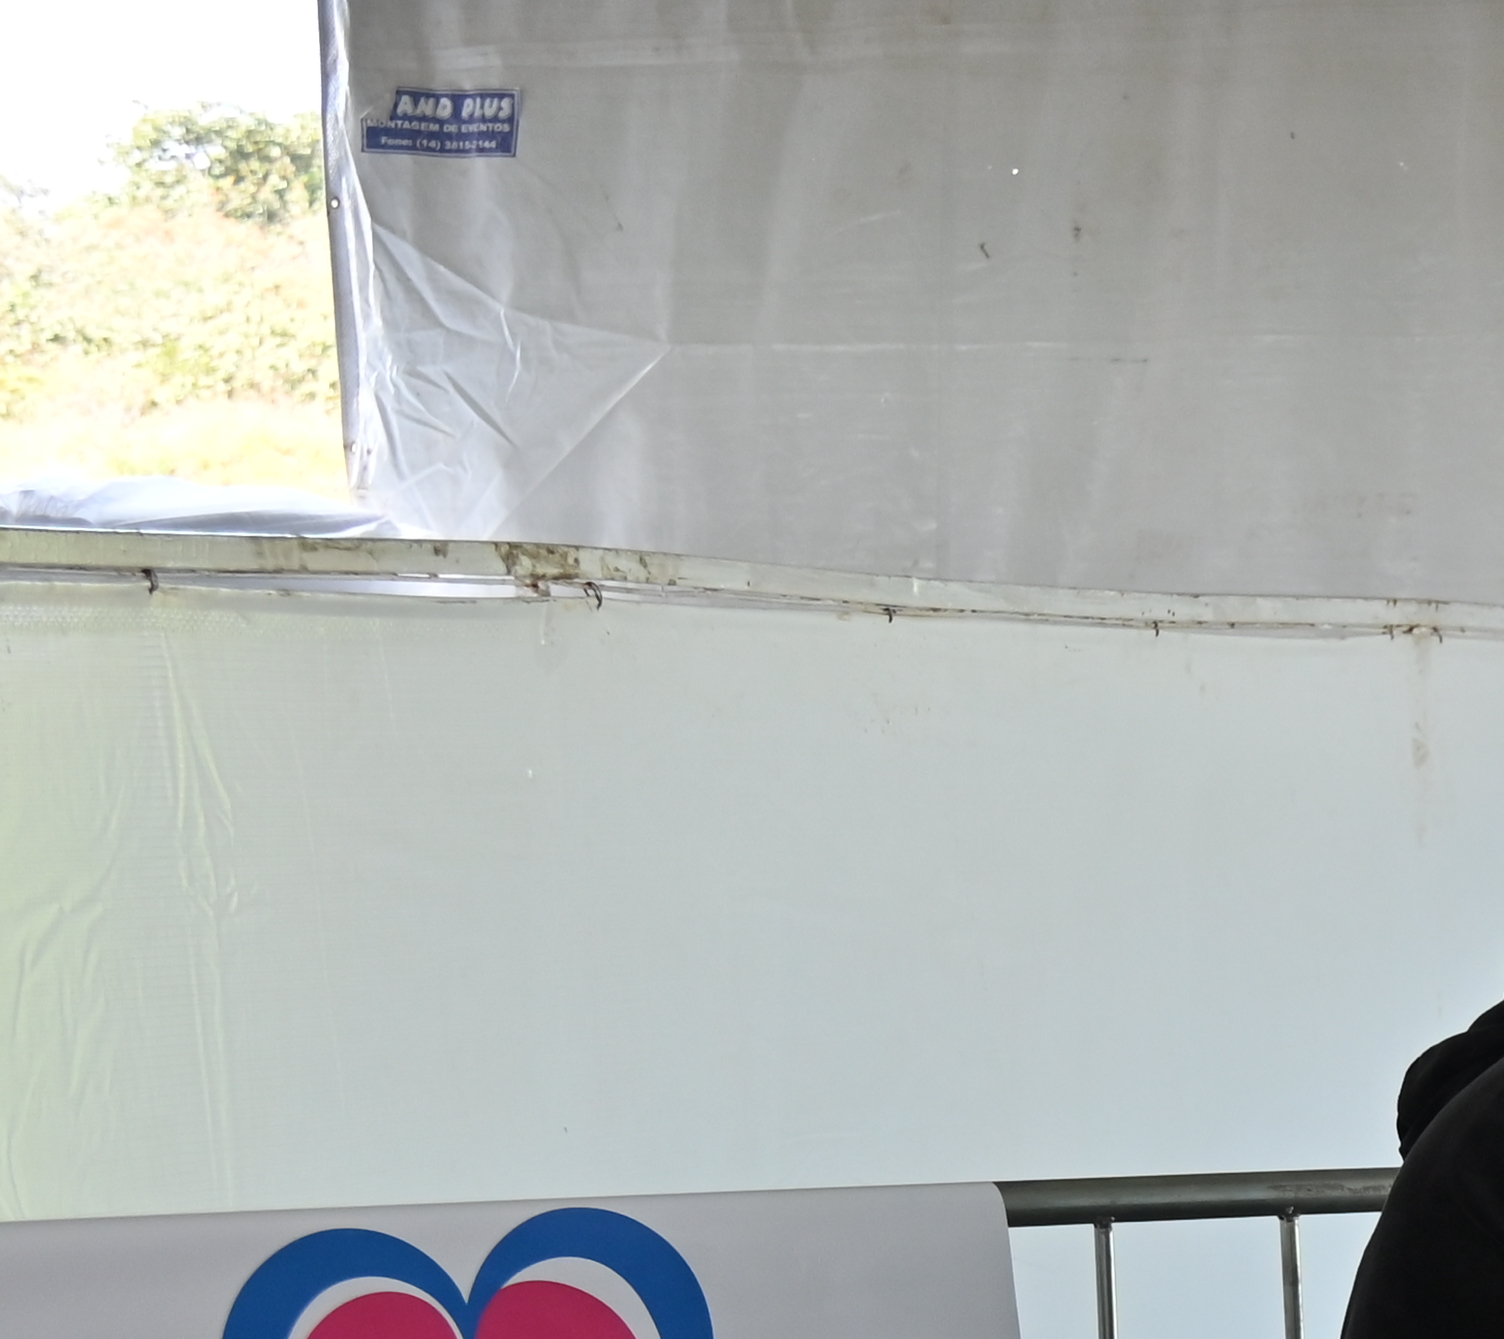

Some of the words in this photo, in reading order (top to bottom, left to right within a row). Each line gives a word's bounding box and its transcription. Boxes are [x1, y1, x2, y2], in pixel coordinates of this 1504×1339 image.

[397, 94, 453, 119] AND
[461, 96, 514, 120] PLUS
[443, 124, 459, 132] DE
